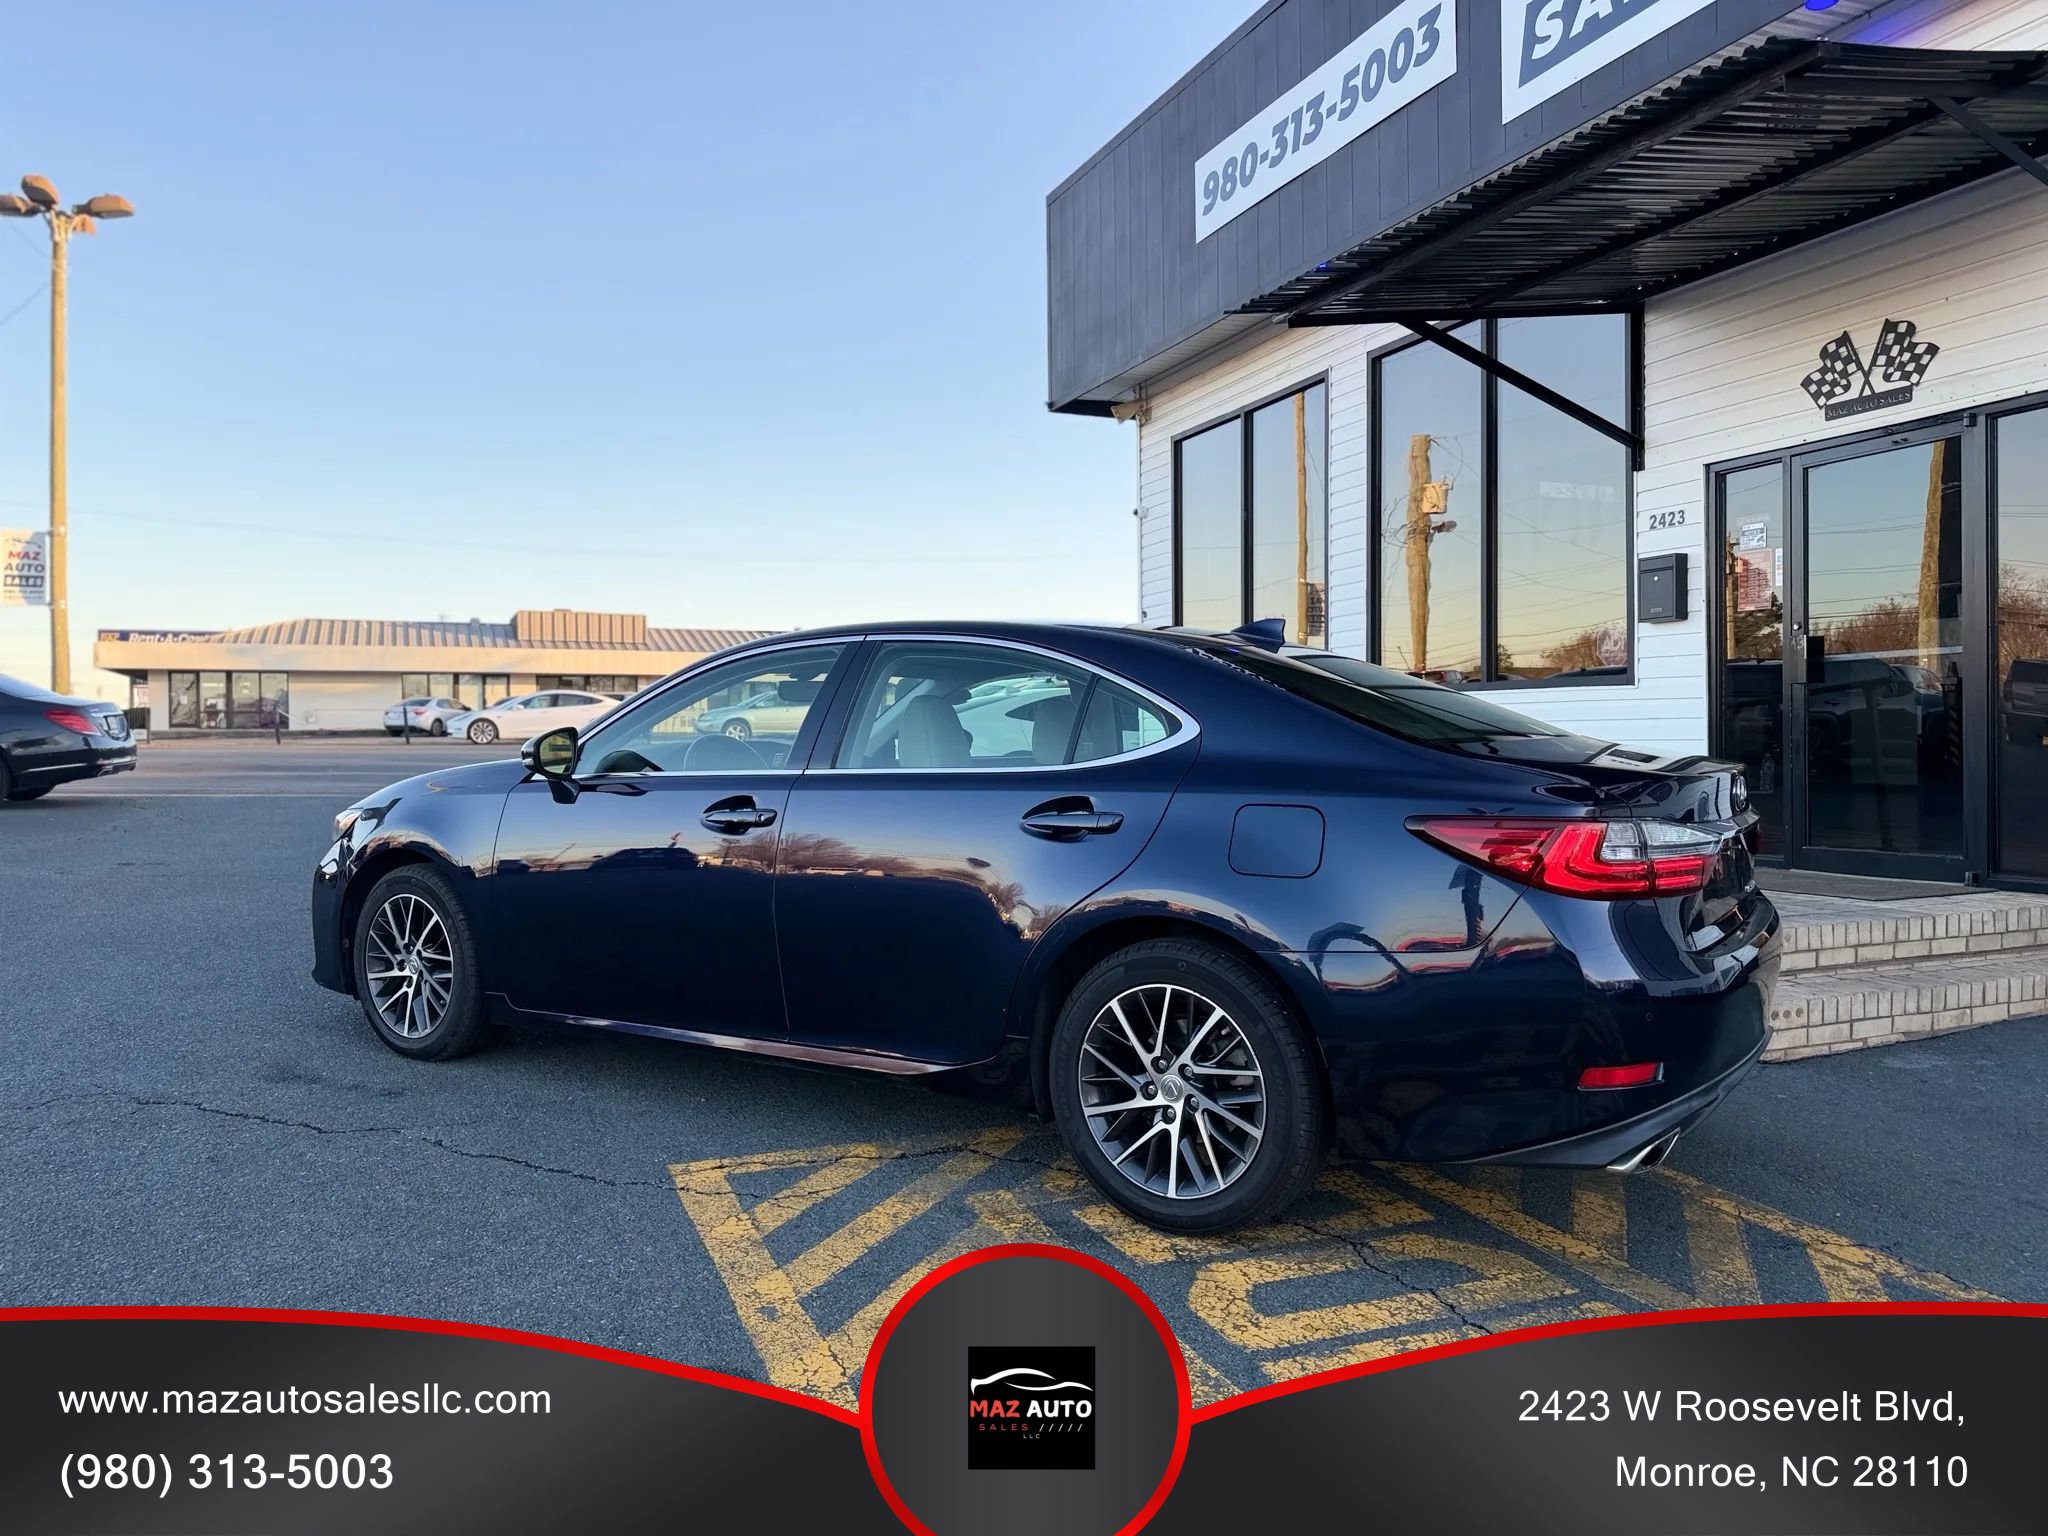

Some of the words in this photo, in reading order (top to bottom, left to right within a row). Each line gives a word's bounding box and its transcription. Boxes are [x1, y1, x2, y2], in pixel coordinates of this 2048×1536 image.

[1202, 2, 1442, 216] 980-313-5003
[1827, 405, 1849, 418] MAZ
[1850, 398, 1878, 413] AUTO
[1879, 392, 1910, 405] SALES
[1649, 510, 1685, 530] 2423
[8, 550, 41, 561] MAZ
[4, 562, 45, 573] AUTO
